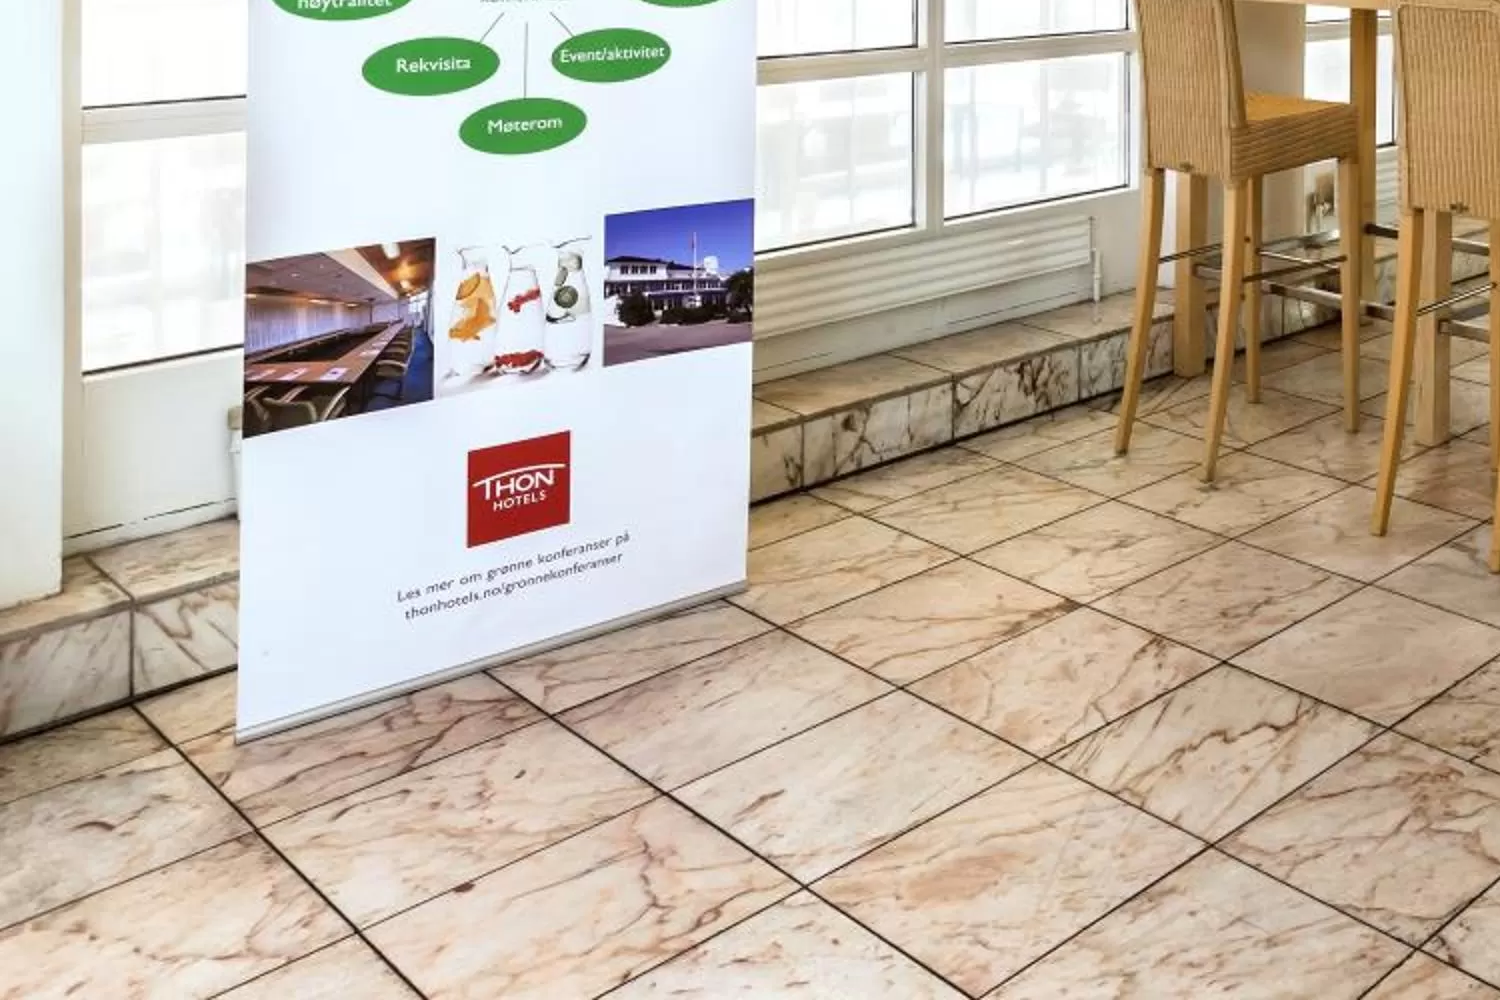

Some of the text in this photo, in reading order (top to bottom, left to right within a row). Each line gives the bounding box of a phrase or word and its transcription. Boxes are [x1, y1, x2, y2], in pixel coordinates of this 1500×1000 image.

[559, 44, 665, 64] Event/aktivitet
[396, 55, 472, 75] Rekvisita
[487, 114, 564, 135] Møterom
[475, 464, 564, 500] THON
[492, 489, 548, 511] HOTELS
[396, 529, 631, 603] Les mer om grønne konferanser på
